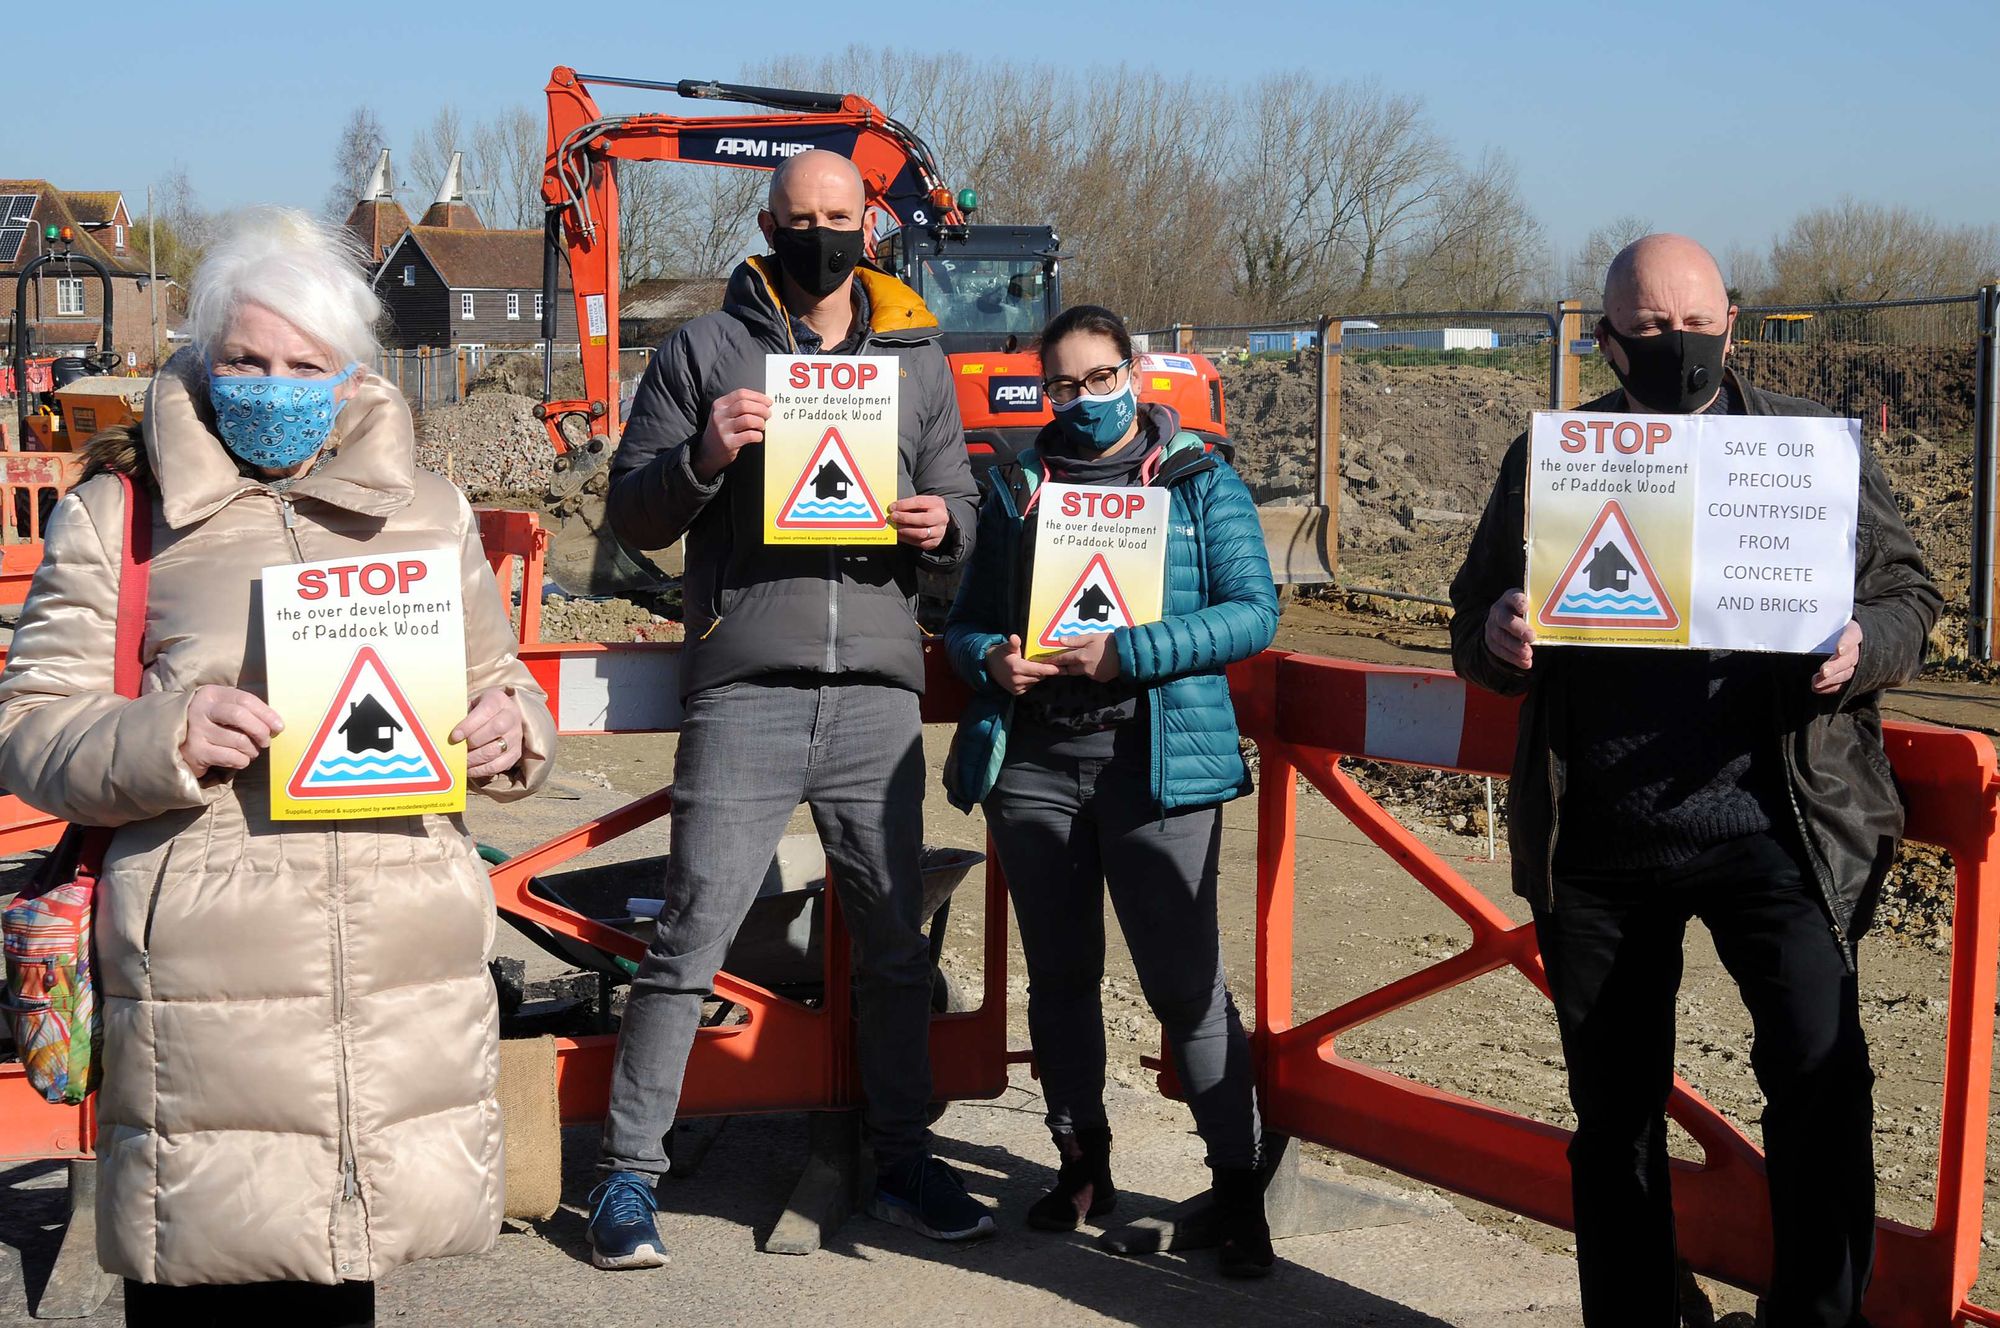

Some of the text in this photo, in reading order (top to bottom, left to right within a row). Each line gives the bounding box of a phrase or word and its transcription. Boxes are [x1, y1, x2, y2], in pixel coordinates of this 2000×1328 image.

[715, 137, 768, 157] APM
[788, 362, 878, 390] STOP
[774, 393, 891, 408] the over development
[995, 386, 1037, 400] APM
[783, 409, 882, 421] of Paddock Wood
[1560, 420, 1672, 455] STOP
[1724, 441, 1815, 457] SAVE OUR
[1540, 457, 1689, 478] the over development
[1551, 478, 1676, 494] of Paddock Wood
[1728, 473, 1812, 489] PRECIOUS
[1061, 491, 1145, 519] STOP
[1708, 503, 1827, 520] COUNTRYSIDE
[1045, 519, 1157, 537] the over development
[1053, 535, 1147, 550] of Paddock Wood
[1739, 535, 1789, 550] FROM
[297, 559, 428, 600] STOP
[1723, 565, 1813, 582] CONCRETE
[277, 600, 452, 621] the over development
[1716, 596, 1818, 613] AND BRICKS
[292, 620, 439, 641] of Paddock Wood
[285, 808, 313, 816] Supplied,
[342, 806, 372, 814] supported
